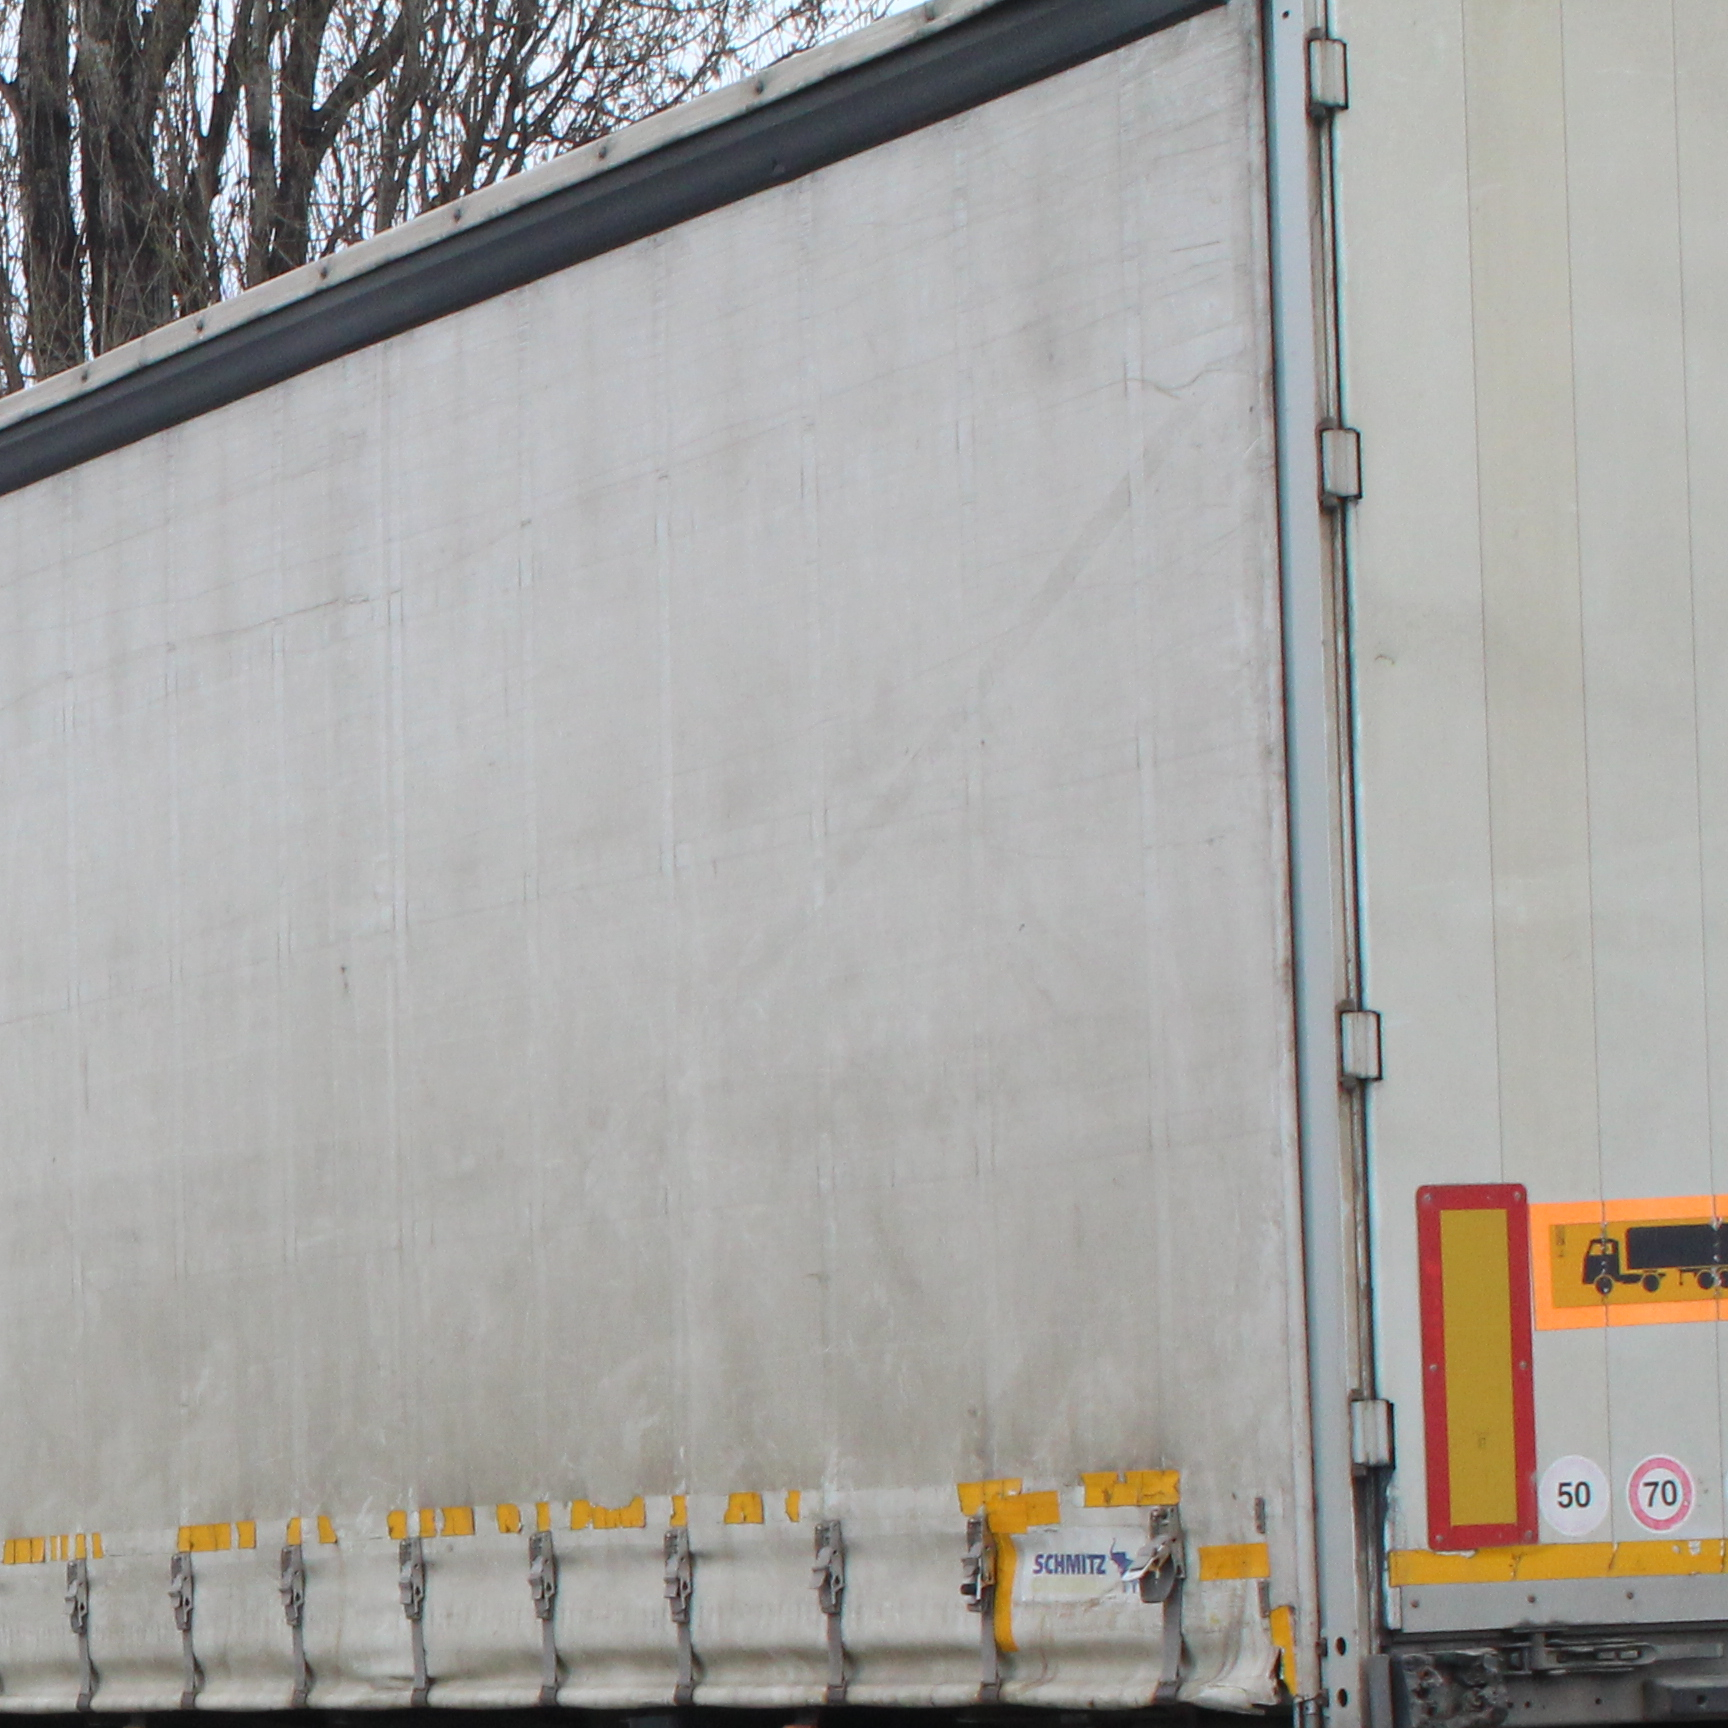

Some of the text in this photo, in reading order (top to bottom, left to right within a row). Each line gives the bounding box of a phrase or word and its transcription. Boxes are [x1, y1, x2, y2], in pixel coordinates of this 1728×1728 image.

[1557, 1481, 1591, 1509] 50
[1644, 1480, 1677, 1508] 70
[1032, 1553, 1107, 1575] SCHMITZ
